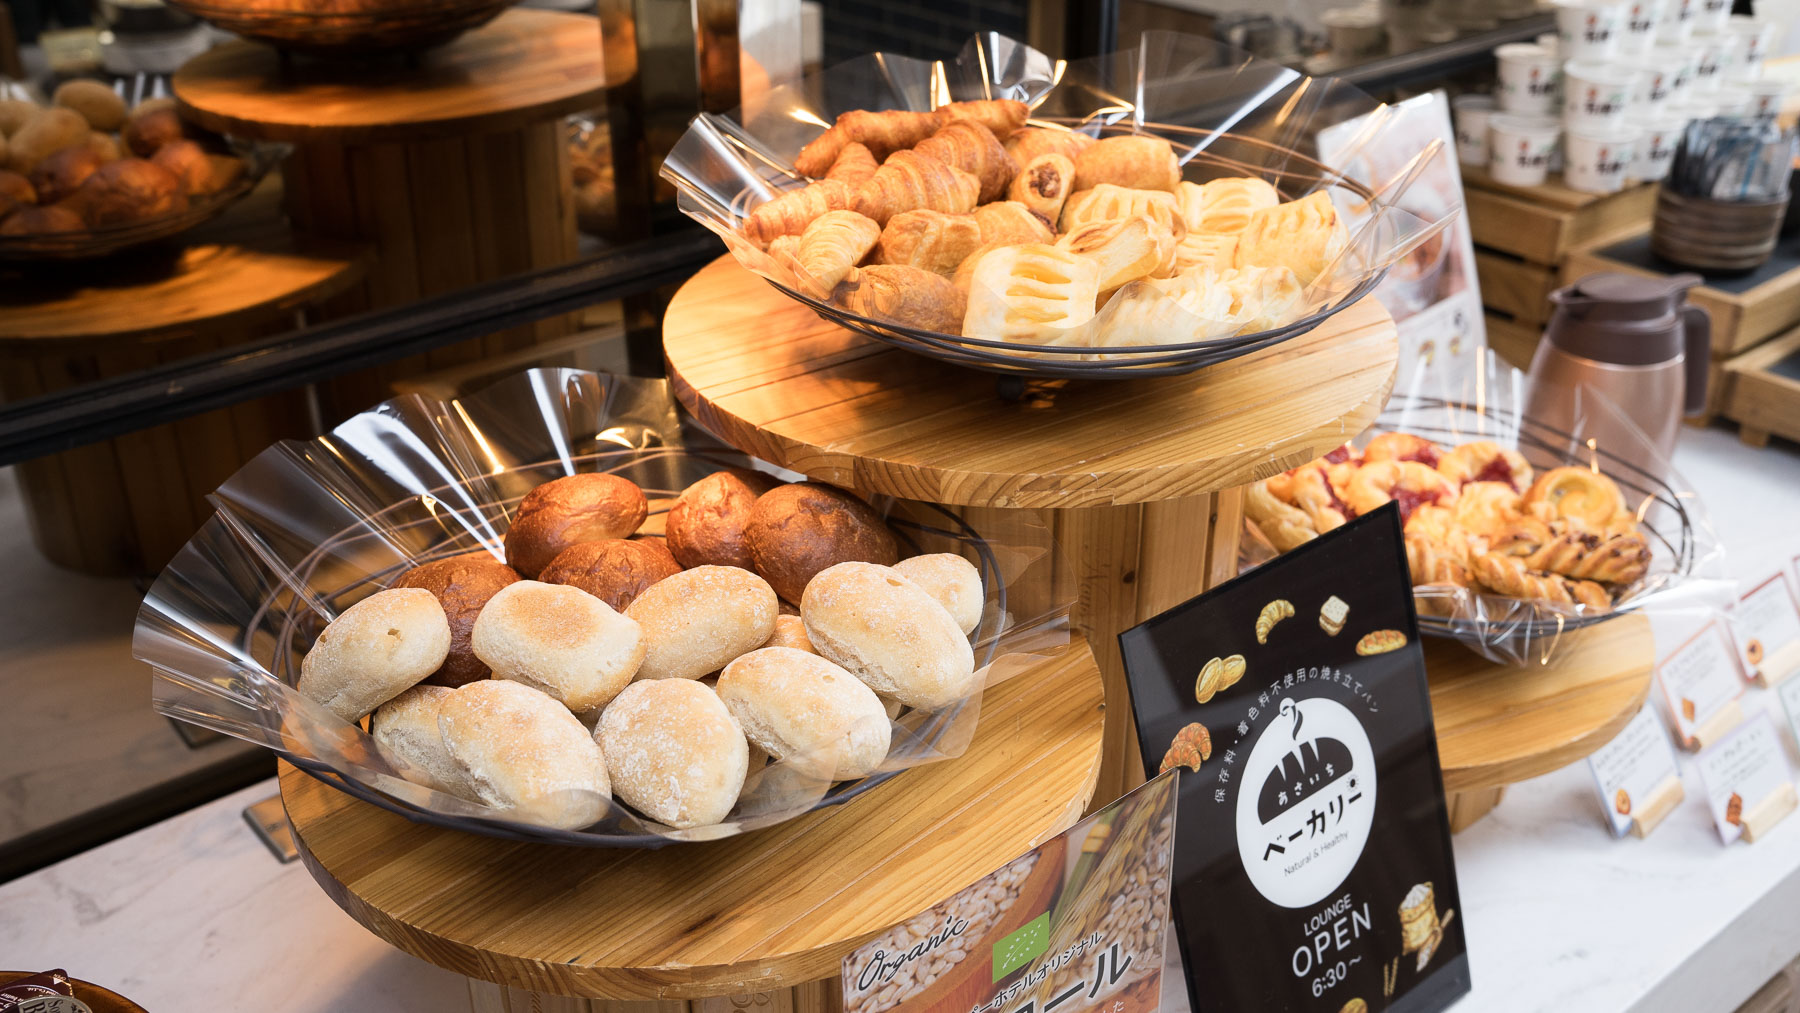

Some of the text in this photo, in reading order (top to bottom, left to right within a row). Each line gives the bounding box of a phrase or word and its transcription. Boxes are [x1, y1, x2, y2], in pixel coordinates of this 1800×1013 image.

[1277, 762, 1335, 807] あさいち
[1262, 791, 1363, 862] ベーカリー
[1284, 830, 1350, 878] Natural & Healthy
[1292, 902, 1372, 977] OPEN
[1303, 893, 1352, 937] LOUNGE
[858, 915, 969, 991] Organic
[1013, 943, 1133, 1013] ール
